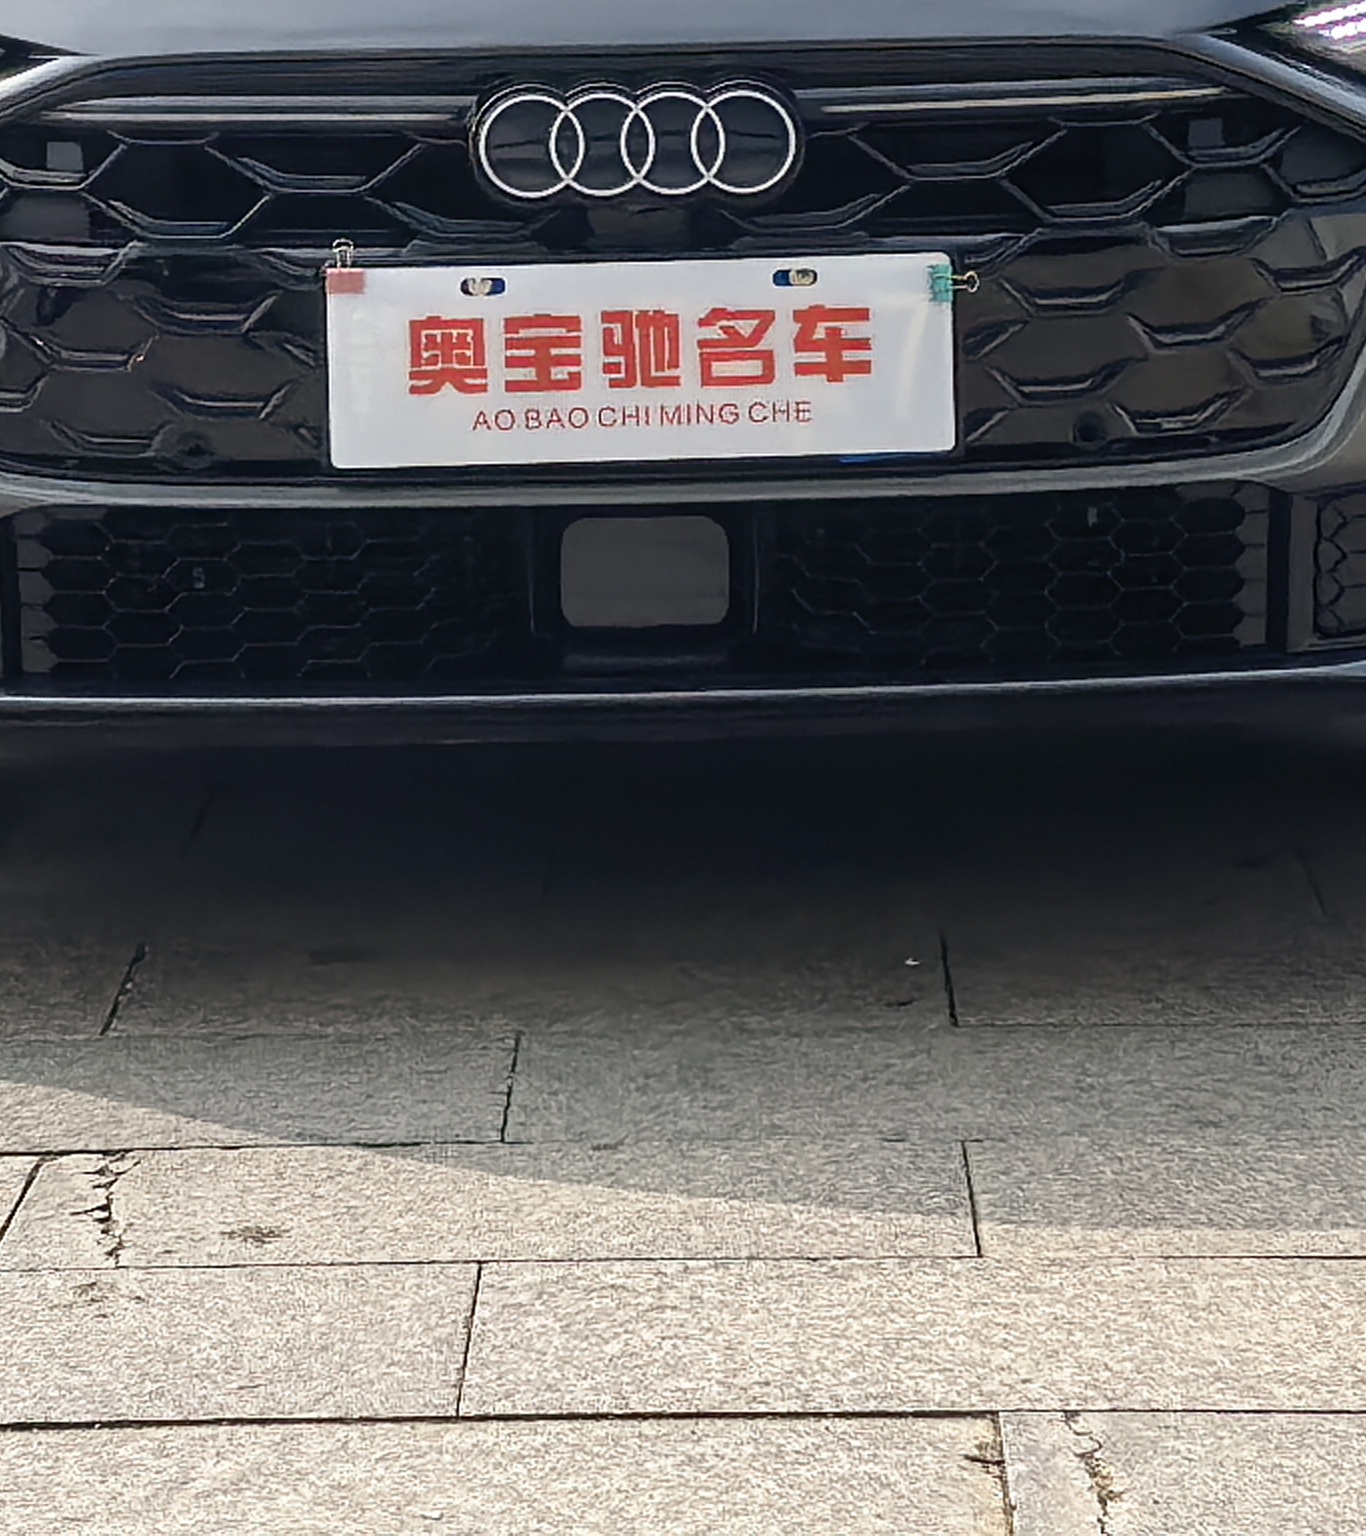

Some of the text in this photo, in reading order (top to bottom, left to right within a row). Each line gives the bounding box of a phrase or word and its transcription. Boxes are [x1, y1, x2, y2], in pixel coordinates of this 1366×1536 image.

[408, 305, 872, 395] 奥宝驰名车
[471, 400, 813, 431] AO BAO CHI MING CHE
